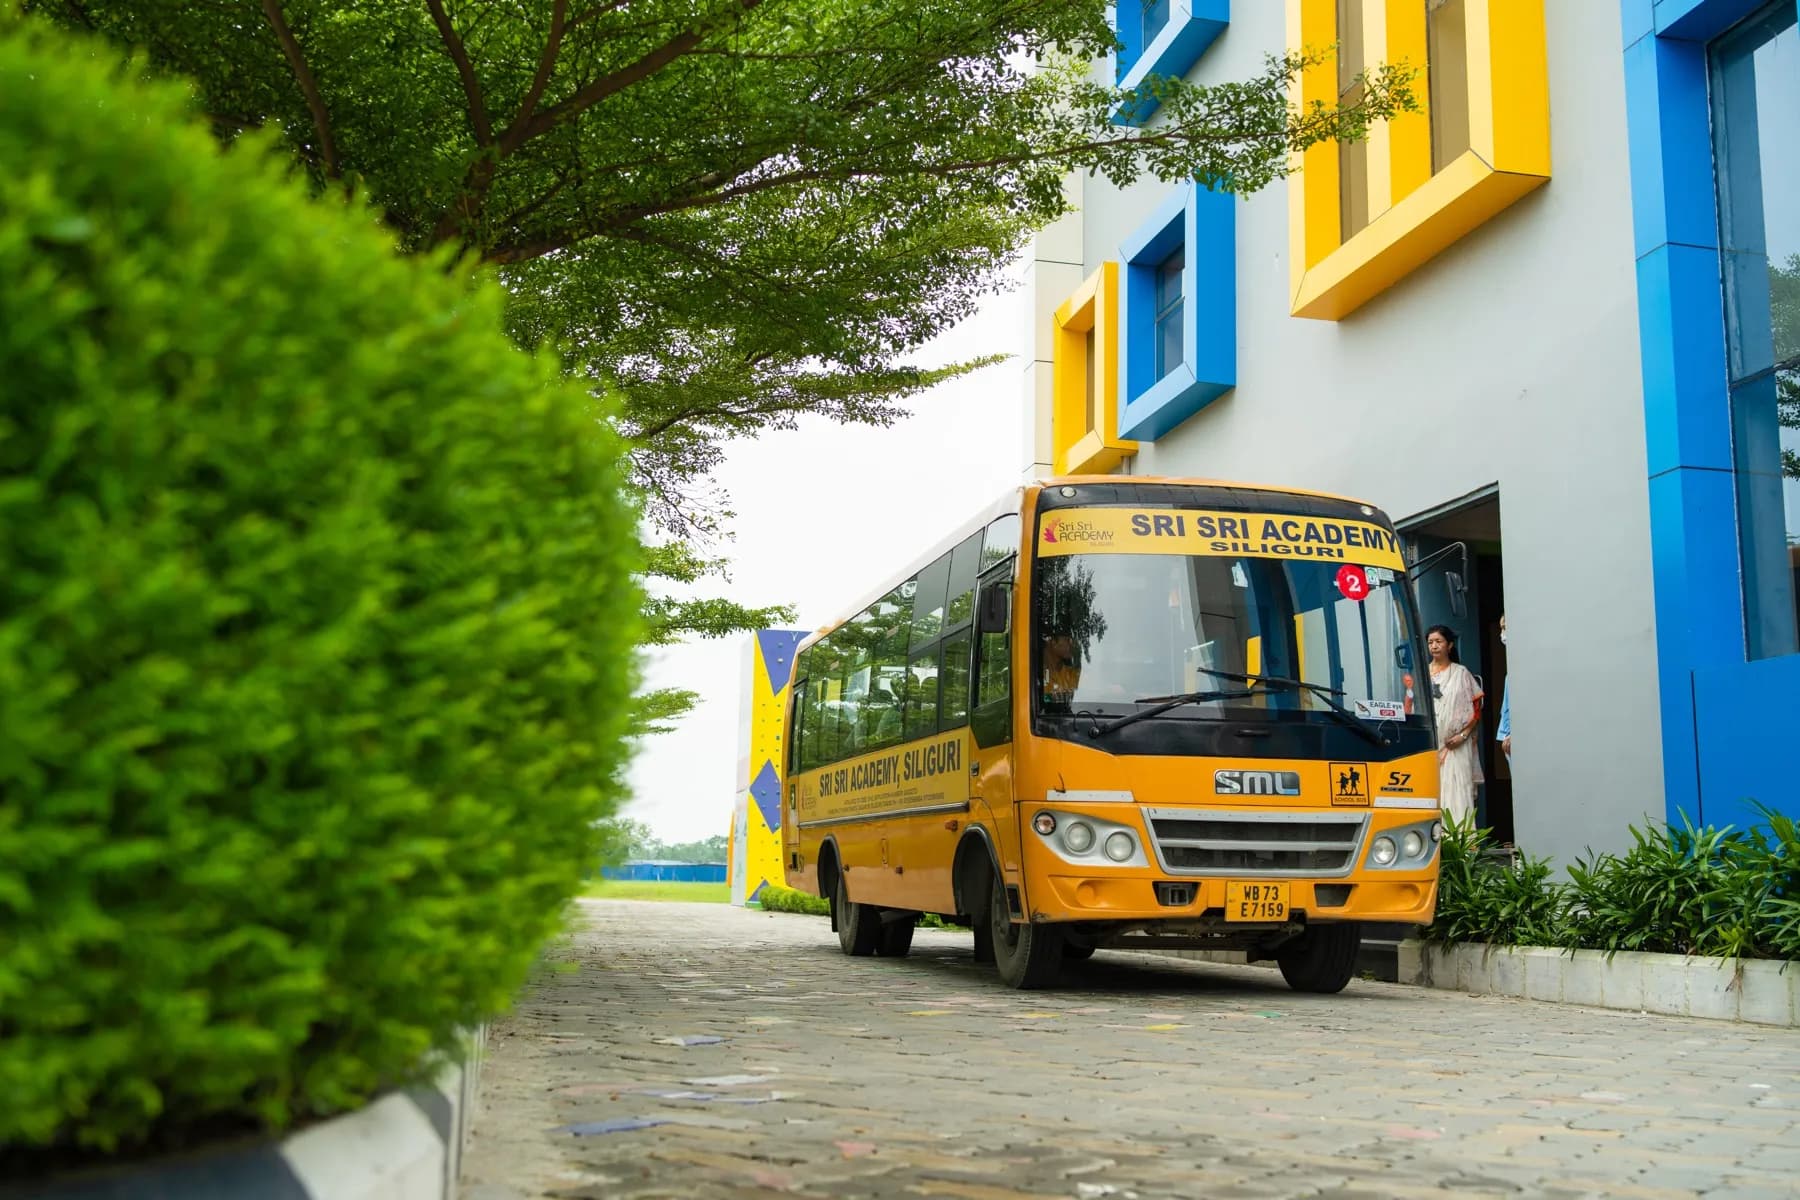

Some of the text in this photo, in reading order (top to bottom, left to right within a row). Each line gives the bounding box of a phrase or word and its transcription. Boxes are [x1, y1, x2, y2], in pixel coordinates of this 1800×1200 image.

[1058, 520, 1093, 532] Sri Sri
[1131, 514, 1397, 553] SRI SRI ACADEMY
[1059, 530, 1114, 542] ACADEMY
[1210, 541, 1344, 558] SILIGURI
[1346, 574, 1361, 592] 2
[1369, 701, 1391, 709] EAGLE
[819, 771, 832, 798] SRI
[834, 768, 848, 794] SRI
[850, 756, 900, 790] ACADEMY,
[903, 739, 961, 781] SILIGURI
[1216, 771, 1299, 795] SML
[1388, 771, 1411, 786] S7
[1243, 885, 1279, 900] WB 73
[1240, 902, 1284, 917] E 7159
